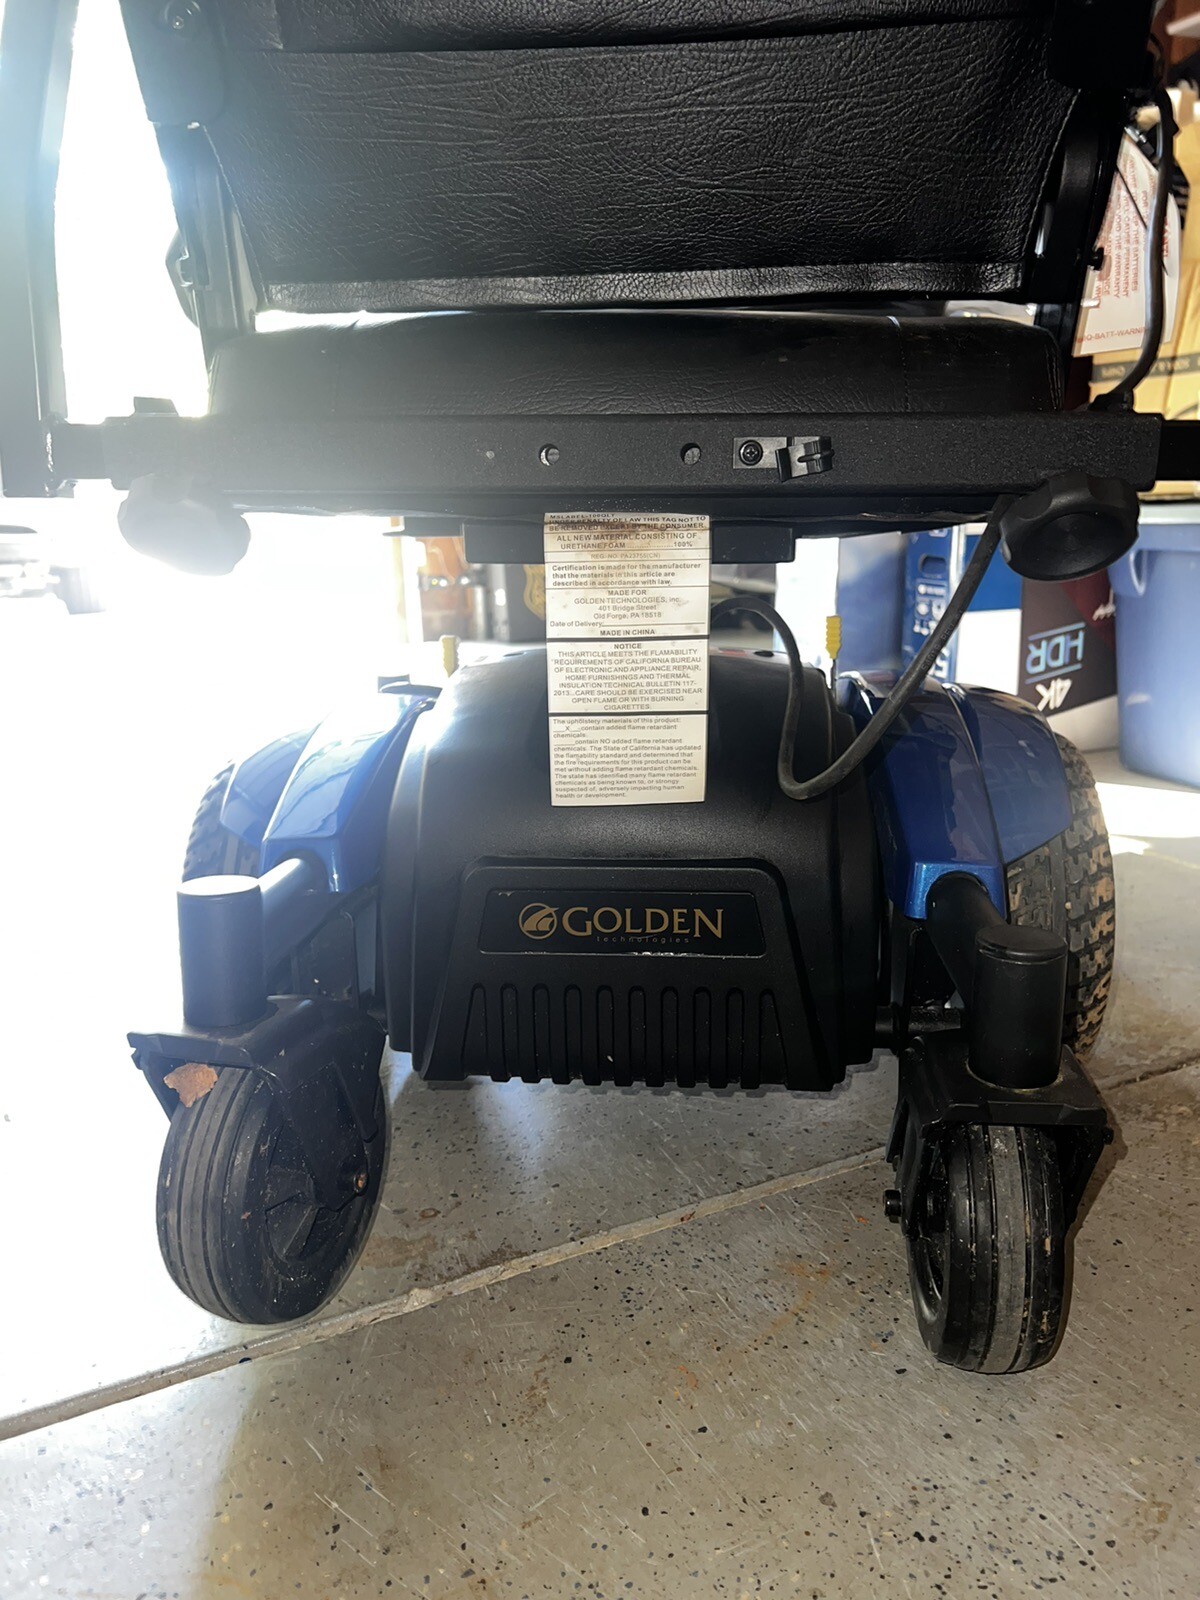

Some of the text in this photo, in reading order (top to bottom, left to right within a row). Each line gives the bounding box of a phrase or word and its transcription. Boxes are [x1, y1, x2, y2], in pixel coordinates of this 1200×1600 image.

[1026, 630, 1084, 674] HDR
[1036, 678, 1072, 711] 4K
[562, 906, 724, 939] GOLDEN
[597, 936, 690, 944] technologies
